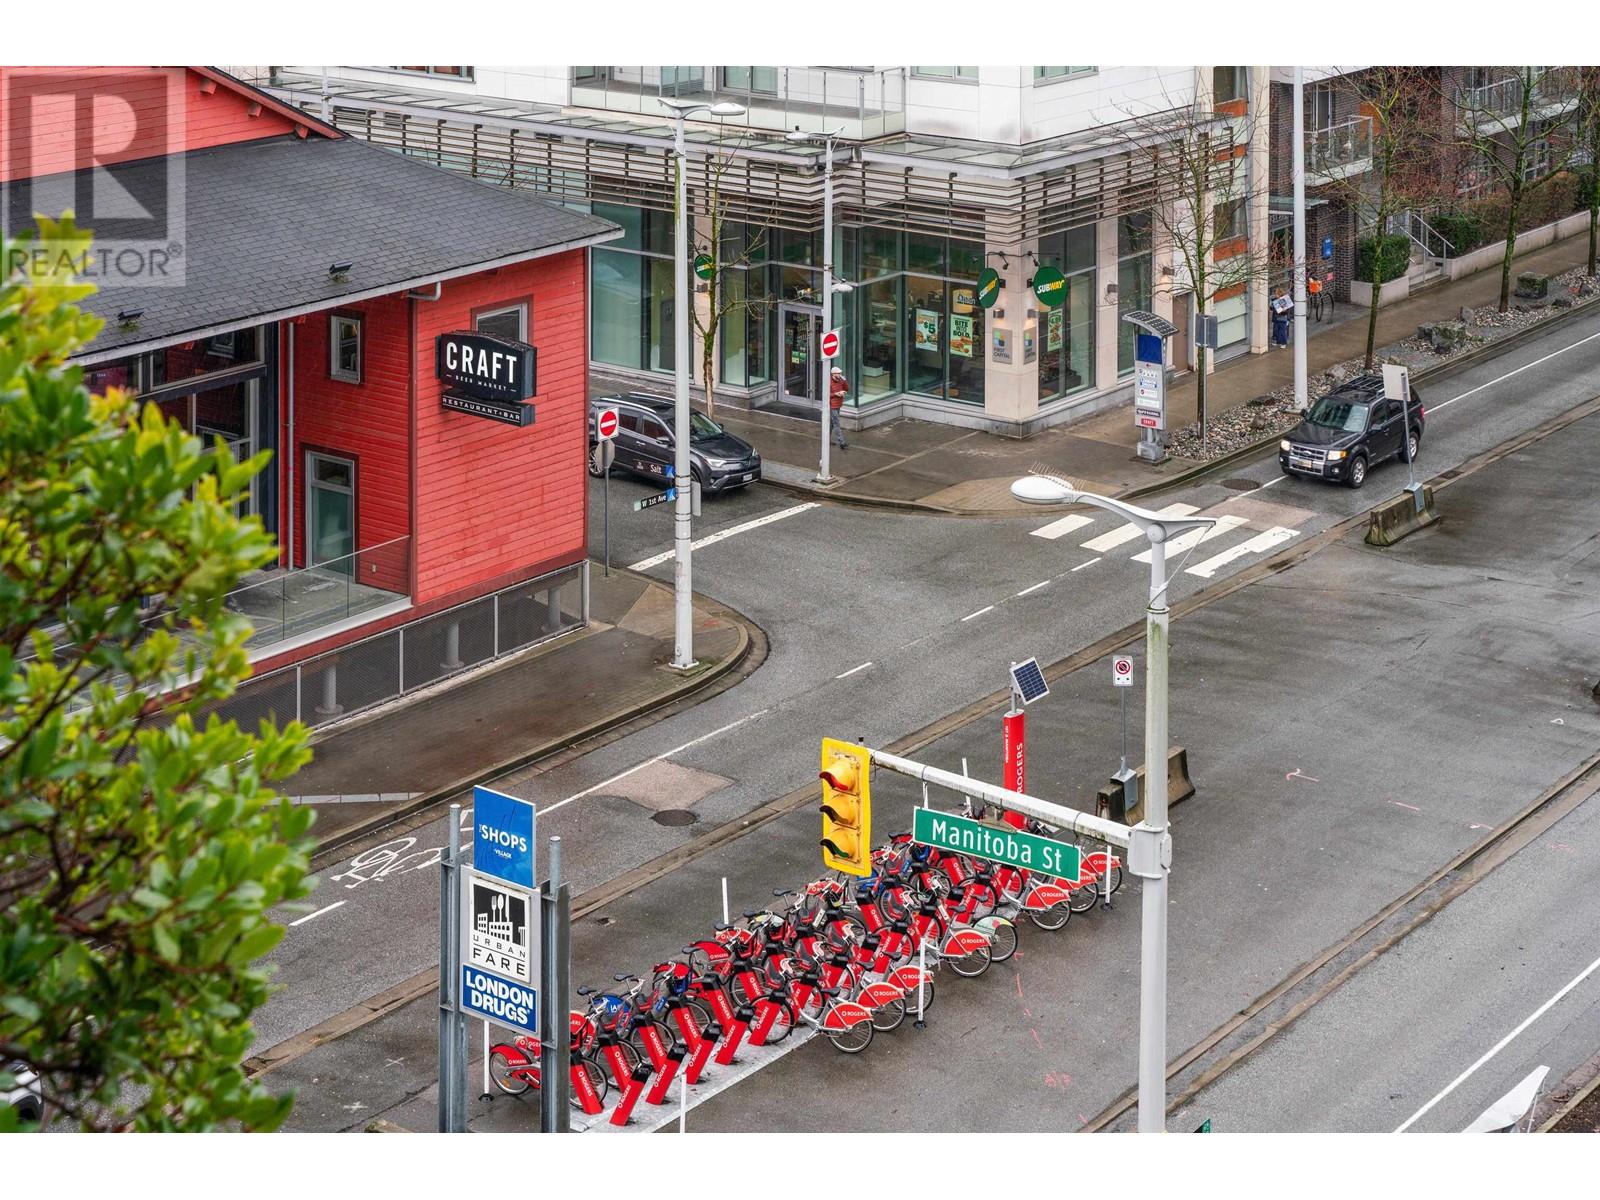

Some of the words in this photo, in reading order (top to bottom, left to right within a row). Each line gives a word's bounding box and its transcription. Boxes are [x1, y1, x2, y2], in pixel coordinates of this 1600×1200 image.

[978, 277, 998, 300] SUBWAY
[1036, 279, 1065, 295] SUBWAY
[446, 341, 517, 384] CRAFT
[455, 375, 473, 384] BEER
[478, 380, 507, 391] MARKET
[649, 495, 657, 506] 1st
[481, 824, 527, 852] SHOPS
[932, 818, 1032, 864] Manitoba
[1042, 846, 1062, 872] St
[473, 934, 526, 958] URBAN
[473, 947, 526, 976] FARE
[466, 970, 534, 1010] LONDON
[719, 1000, 731, 1020] ROGERS
[759, 1006, 769, 1025] ROGERS
[686, 1019, 698, 1038] ROGERS
[726, 1024, 736, 1043] ROGERS
[652, 1037, 664, 1057] ROGERS
[692, 1044, 702, 1063] ROGERS
[617, 1057, 629, 1077] ROGERS
[657, 1064, 667, 1082] ROGERS
[581, 1075, 593, 1097] ROGERS
[621, 1085, 632, 1104] ROGERS
